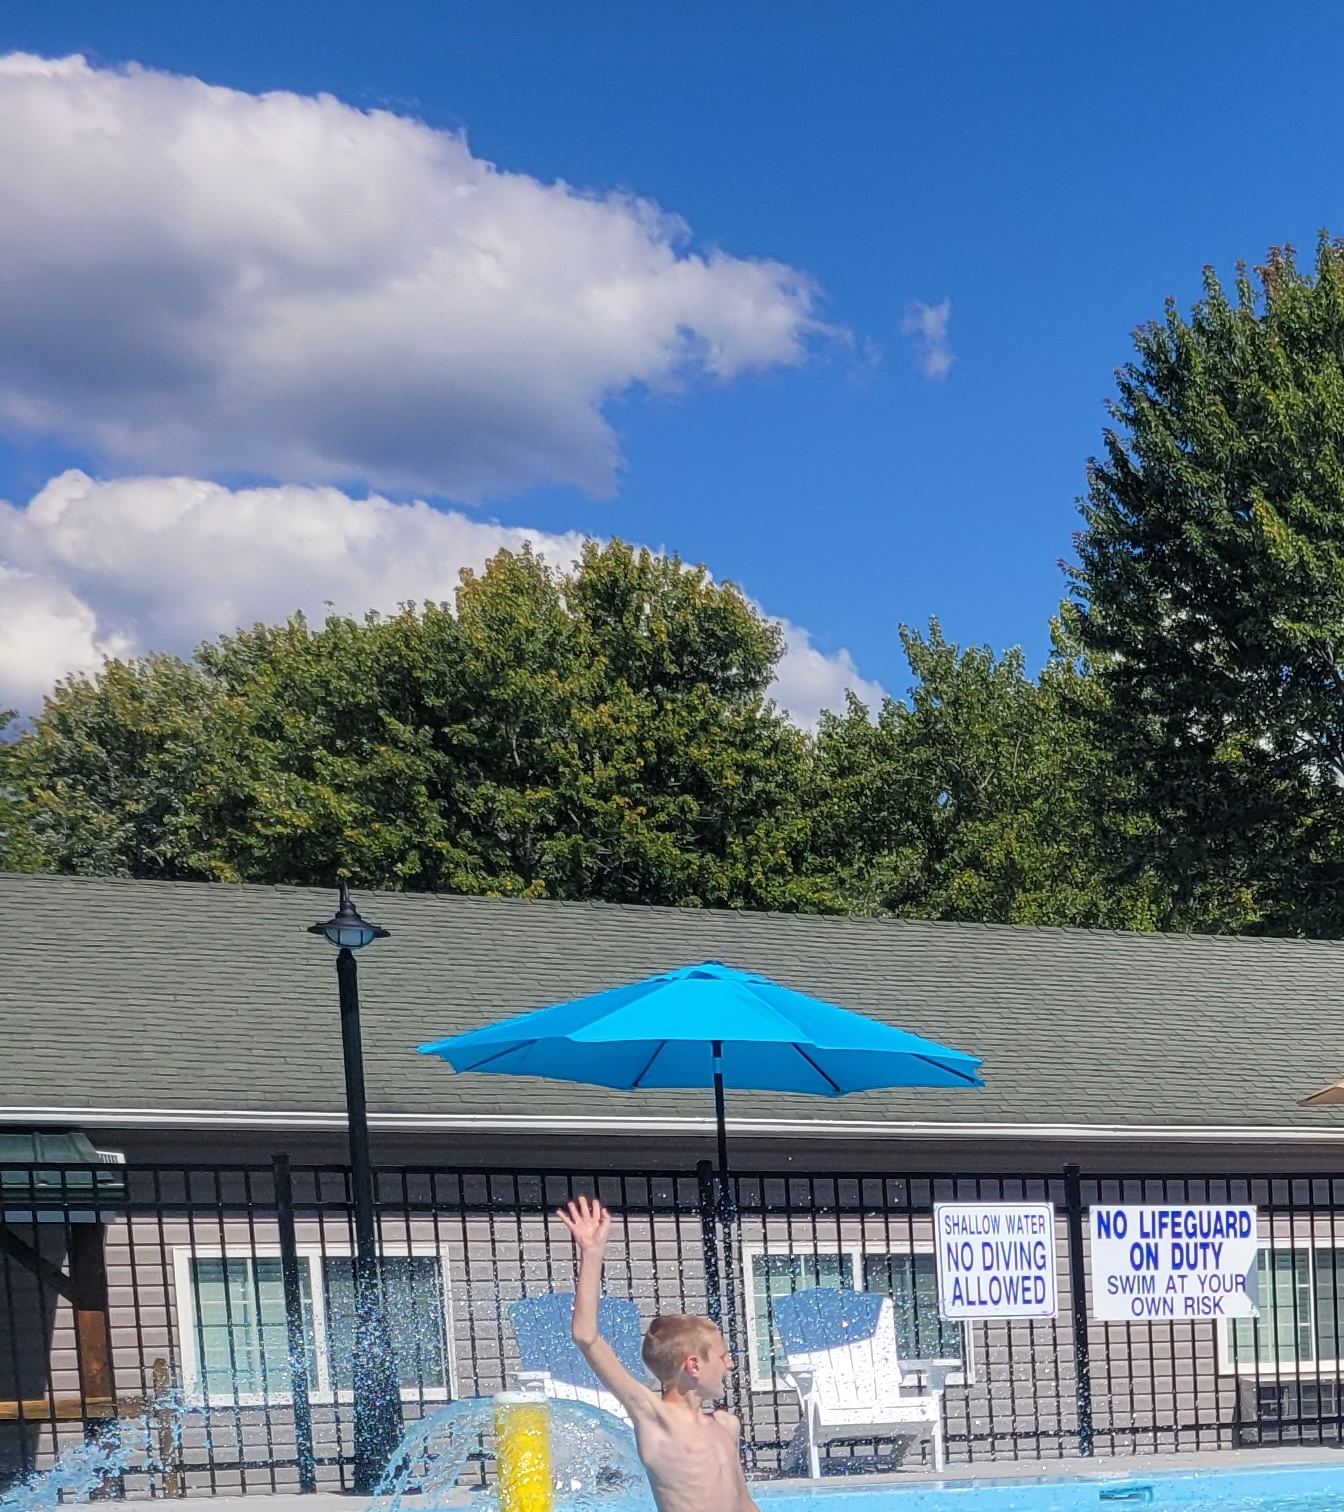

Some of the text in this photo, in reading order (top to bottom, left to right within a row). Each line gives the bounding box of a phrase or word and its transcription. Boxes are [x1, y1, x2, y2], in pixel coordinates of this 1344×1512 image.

[944, 1214, 1046, 1235] SHALLOW WATER
[1096, 1210, 1252, 1240] NO LIFEGUARD
[947, 1241, 1047, 1272] NO DIVING
[1130, 1242, 1224, 1271] ON DUTY
[951, 1275, 1047, 1306] ALLOWED
[1107, 1274, 1247, 1295] SWIM AT YOUR
[1131, 1296, 1225, 1317] OWN RISK
